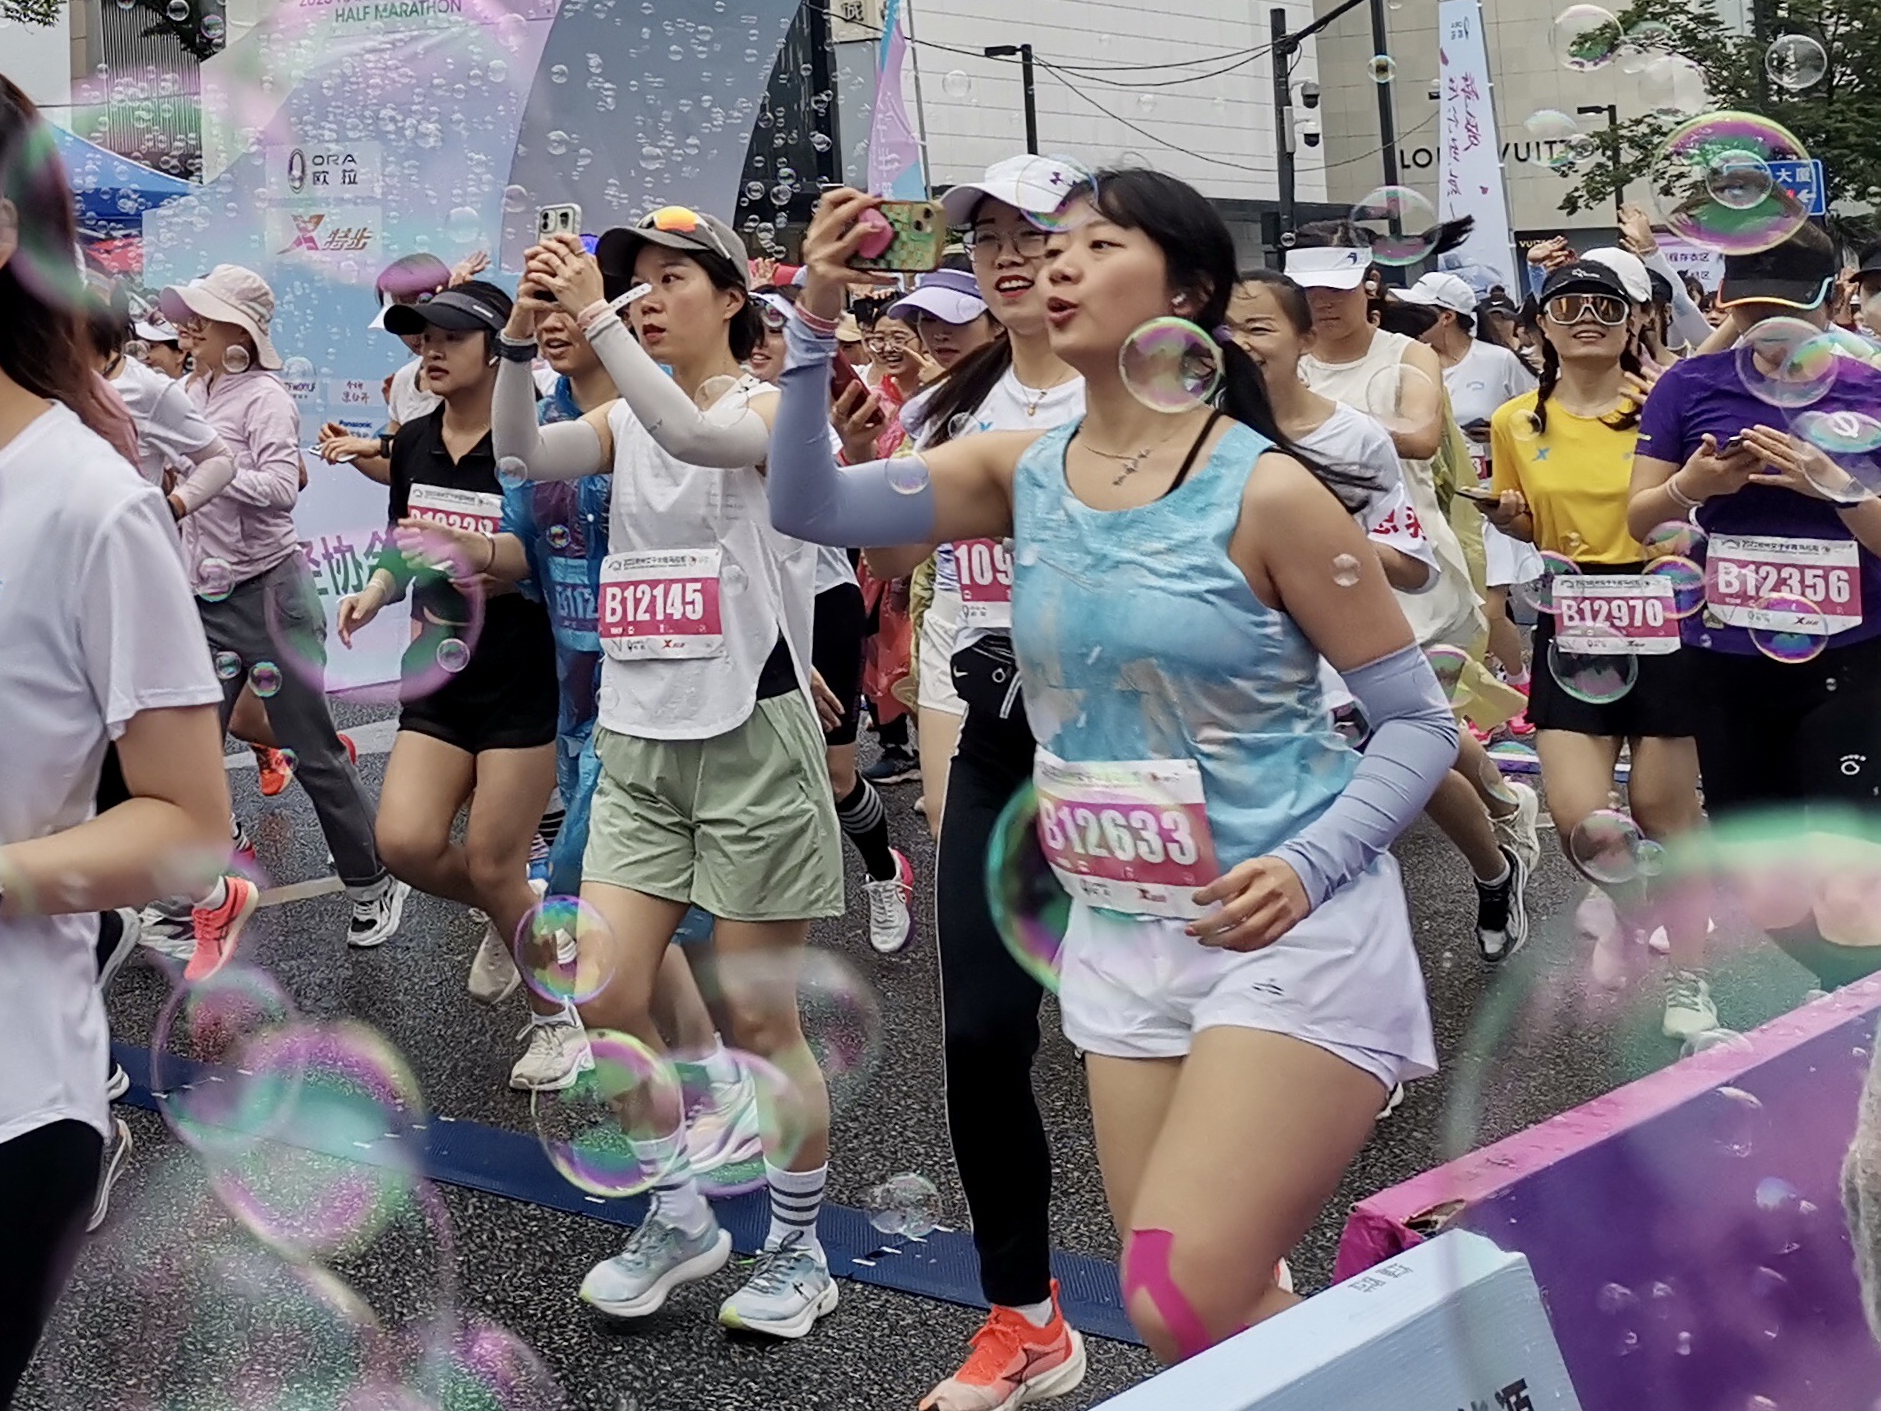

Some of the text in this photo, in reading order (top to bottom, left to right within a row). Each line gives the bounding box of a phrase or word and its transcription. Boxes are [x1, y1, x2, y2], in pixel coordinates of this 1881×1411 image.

[334, 4, 373, 24] HALF
[311, 154, 358, 167] ORA
[312, 169, 358, 186] 欧拉
[321, 227, 375, 251] 特步
[1717, 560, 1851, 603] B12356
[605, 582, 704, 623] B12145
[1561, 598, 1664, 628] B12970
[1040, 798, 1200, 866] B12633
